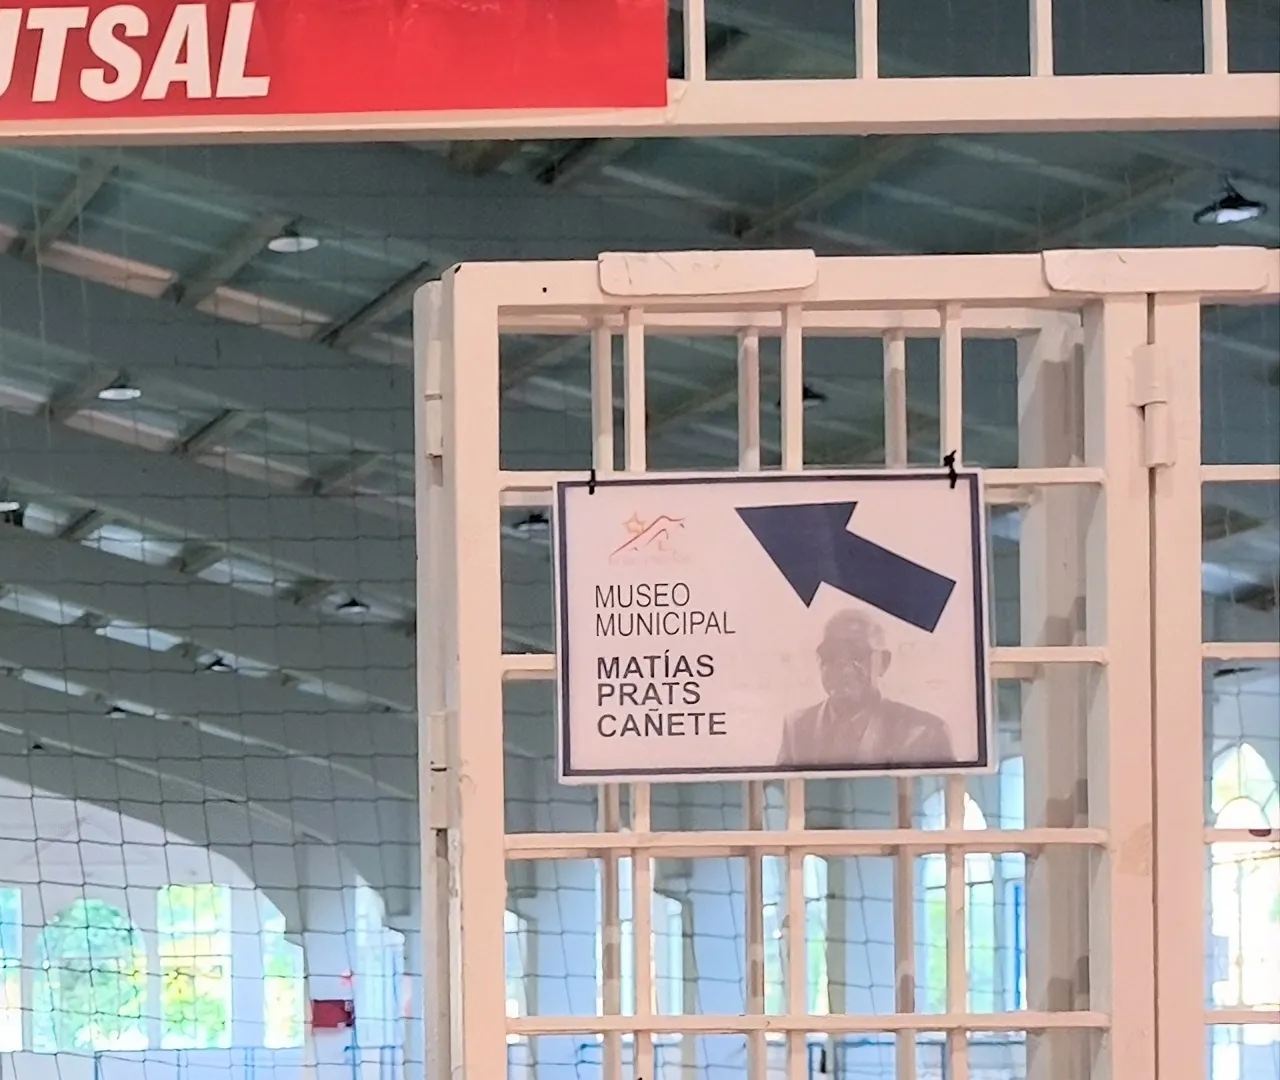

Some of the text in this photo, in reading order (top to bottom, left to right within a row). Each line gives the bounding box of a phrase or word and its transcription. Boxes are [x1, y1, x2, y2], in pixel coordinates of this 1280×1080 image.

[595, 582, 690, 608] MUSEO
[595, 610, 736, 637] MUNICIPAL
[596, 649, 715, 679] MATÍAS
[596, 681, 701, 706] PRATS
[596, 708, 728, 738] CAÑETE
